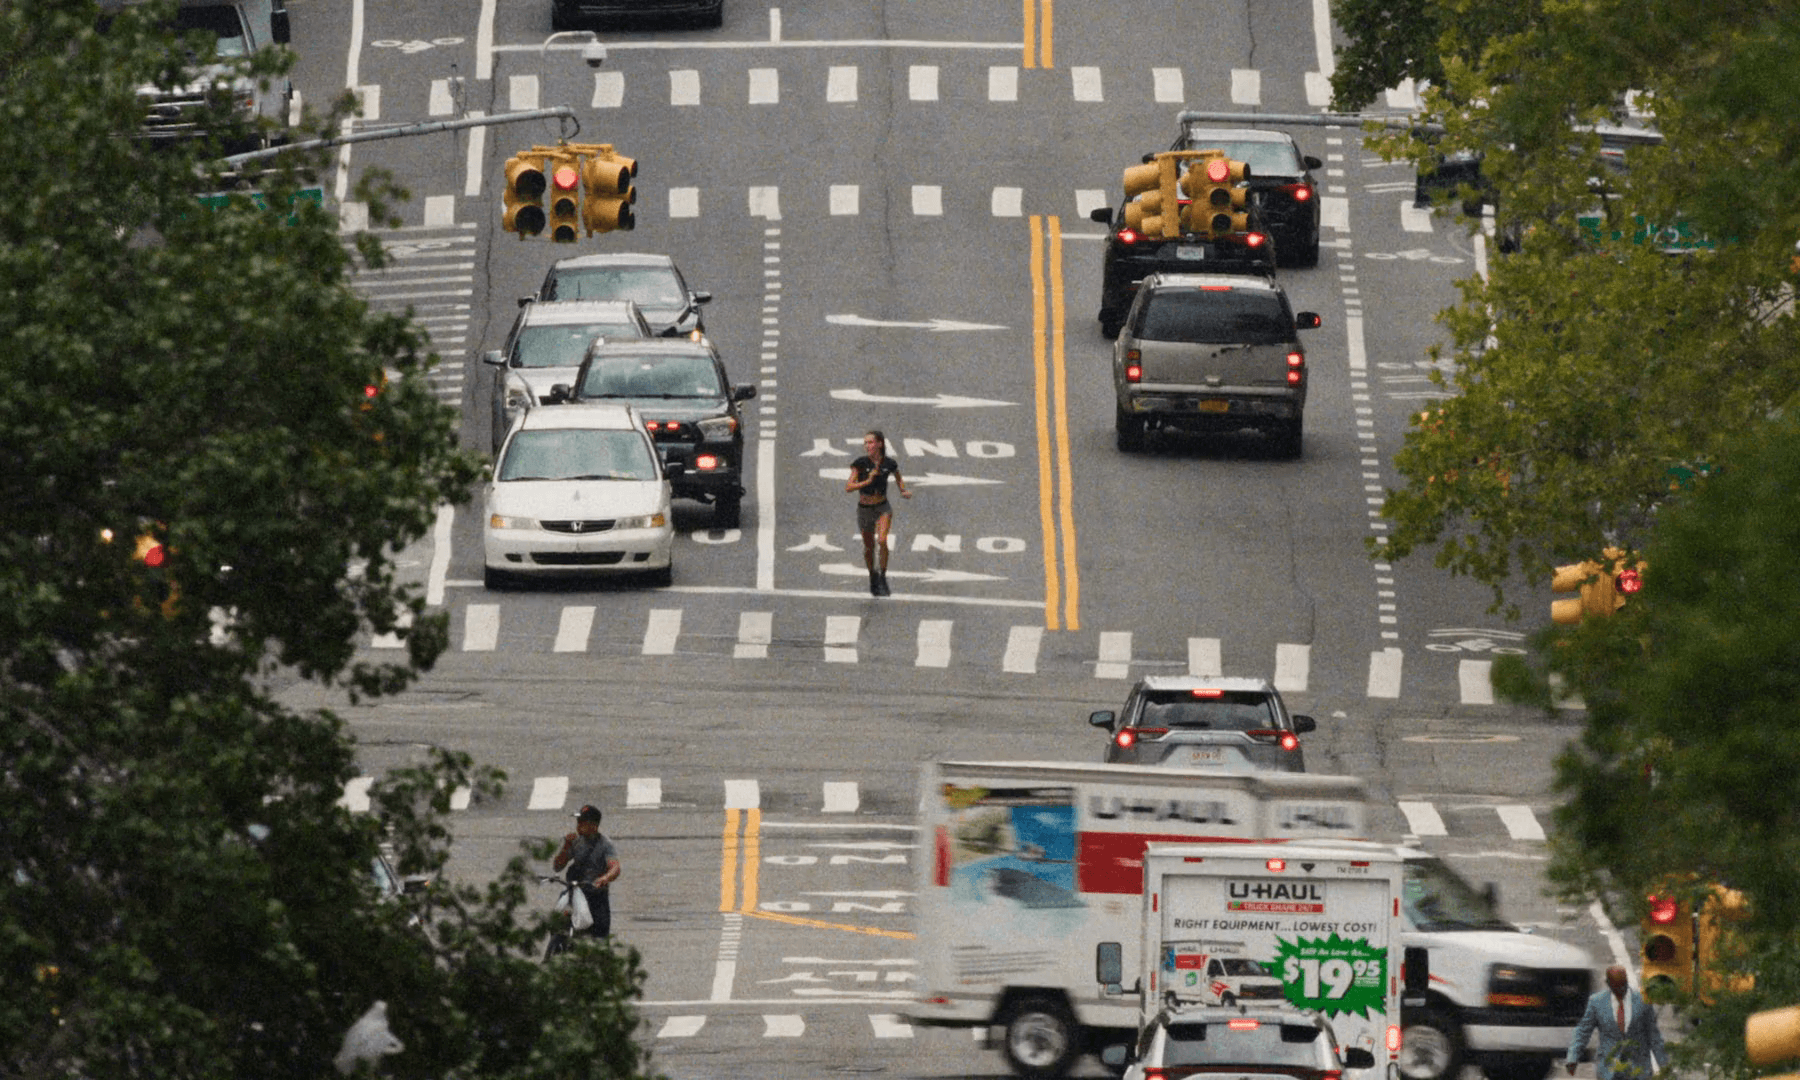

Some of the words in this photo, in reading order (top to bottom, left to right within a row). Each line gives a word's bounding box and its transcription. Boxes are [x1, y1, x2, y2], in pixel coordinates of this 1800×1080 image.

[763, 854, 908, 865] ON
[1230, 882, 1322, 900] U-HAUL
[759, 901, 906, 913] ON
[1244, 902, 1269, 911] TRUCK
[1174, 918, 1209, 929] RIGHT
[1293, 921, 1339, 932] LOWEST
[1343, 922, 1377, 933] COST!
